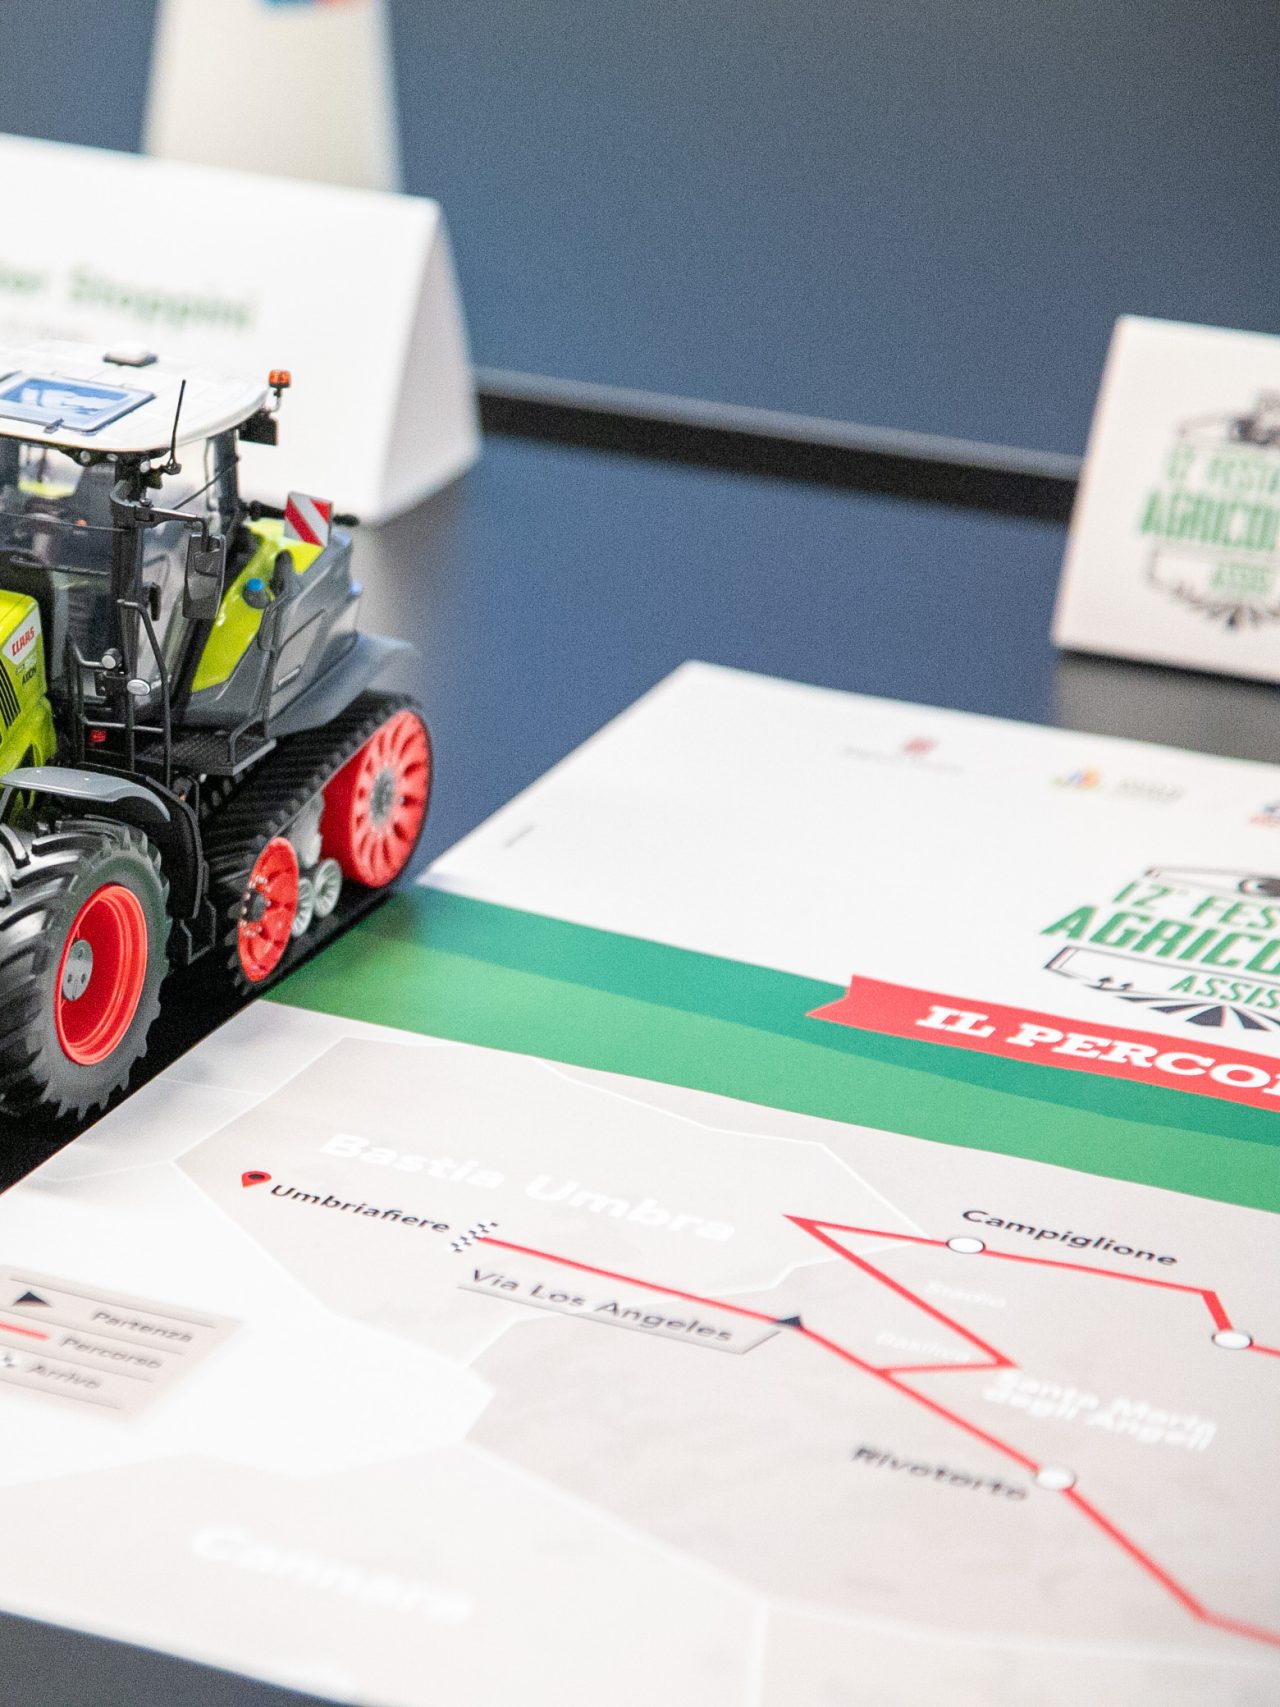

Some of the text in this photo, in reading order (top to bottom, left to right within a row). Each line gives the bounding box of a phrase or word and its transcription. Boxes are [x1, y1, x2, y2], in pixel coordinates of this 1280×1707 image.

[12, 626, 34, 656] CLAAS
[916, 1005, 996, 1038] IL
[270, 1183, 451, 1234] Umbriafiere
[320, 1134, 736, 1243] Bastia Umbra
[962, 1210, 1178, 1266] Campiglione
[471, 1267, 733, 1344] Via Los Angeles
[92, 1311, 194, 1343] Partenza
[61, 1336, 162, 1370] Percorso
[27, 1364, 101, 1389] Arrivo
[852, 1444, 1028, 1501] Rivotorto
